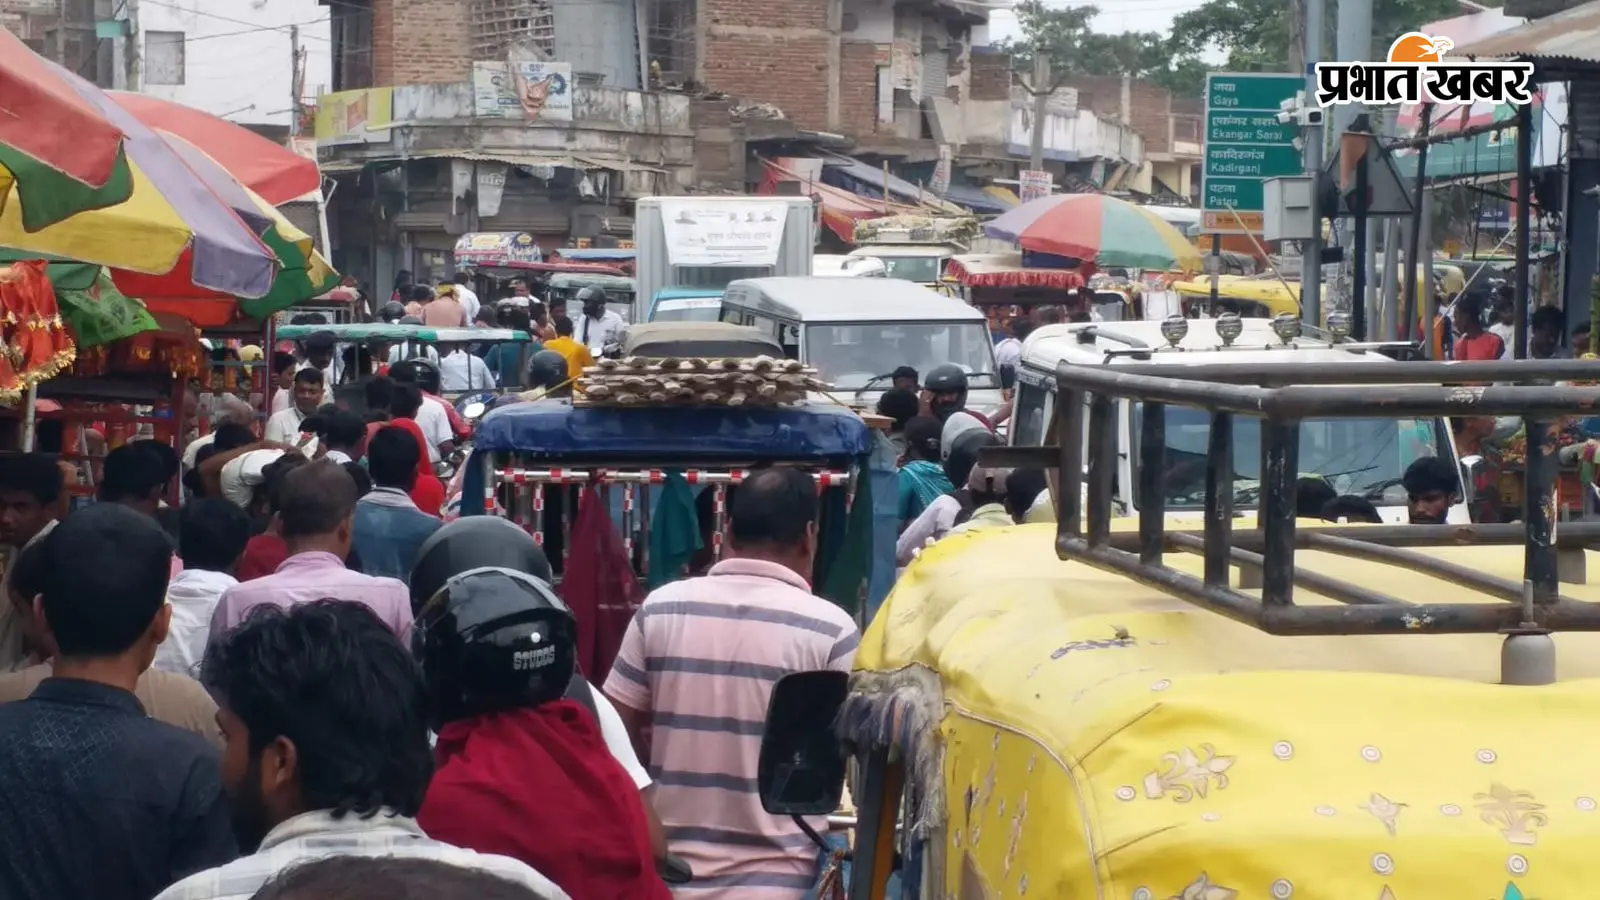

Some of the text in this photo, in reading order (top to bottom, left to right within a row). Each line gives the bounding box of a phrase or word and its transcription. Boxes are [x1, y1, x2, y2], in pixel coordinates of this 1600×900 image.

[1213, 83, 1236, 92] गया
[1213, 95, 1239, 107] Gaya
[1212, 129, 1283, 141] Ekangar Sarai
[1211, 162, 1261, 175] Kadirganj
[1209, 184, 1236, 193] पटना
[513, 644, 556, 670] STUDDS
